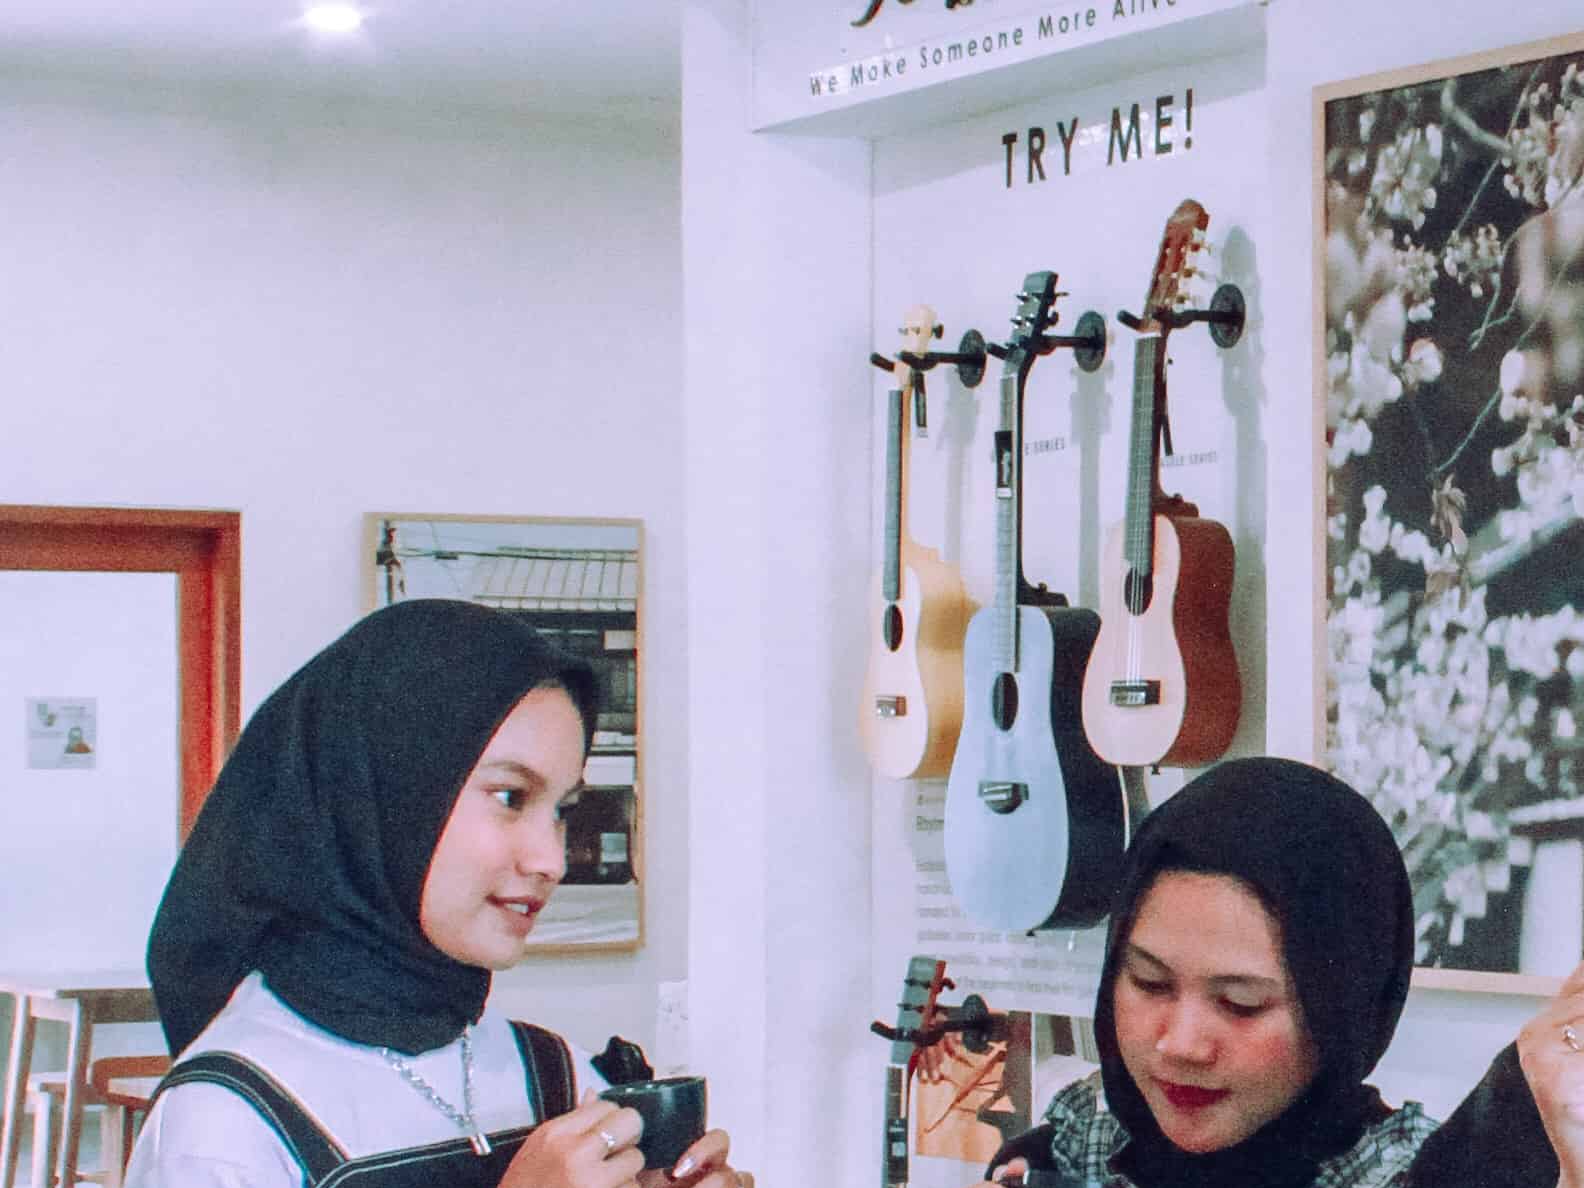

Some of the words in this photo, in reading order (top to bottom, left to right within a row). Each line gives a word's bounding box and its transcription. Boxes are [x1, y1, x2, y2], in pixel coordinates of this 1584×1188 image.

[809, 73, 840, 96] We
[850, 55, 907, 88] Make
[918, 24, 1024, 69] Someone
[1037, 8, 1097, 41] More
[1001, 116, 1080, 188] TRY
[1107, 88, 1193, 166] ME!
